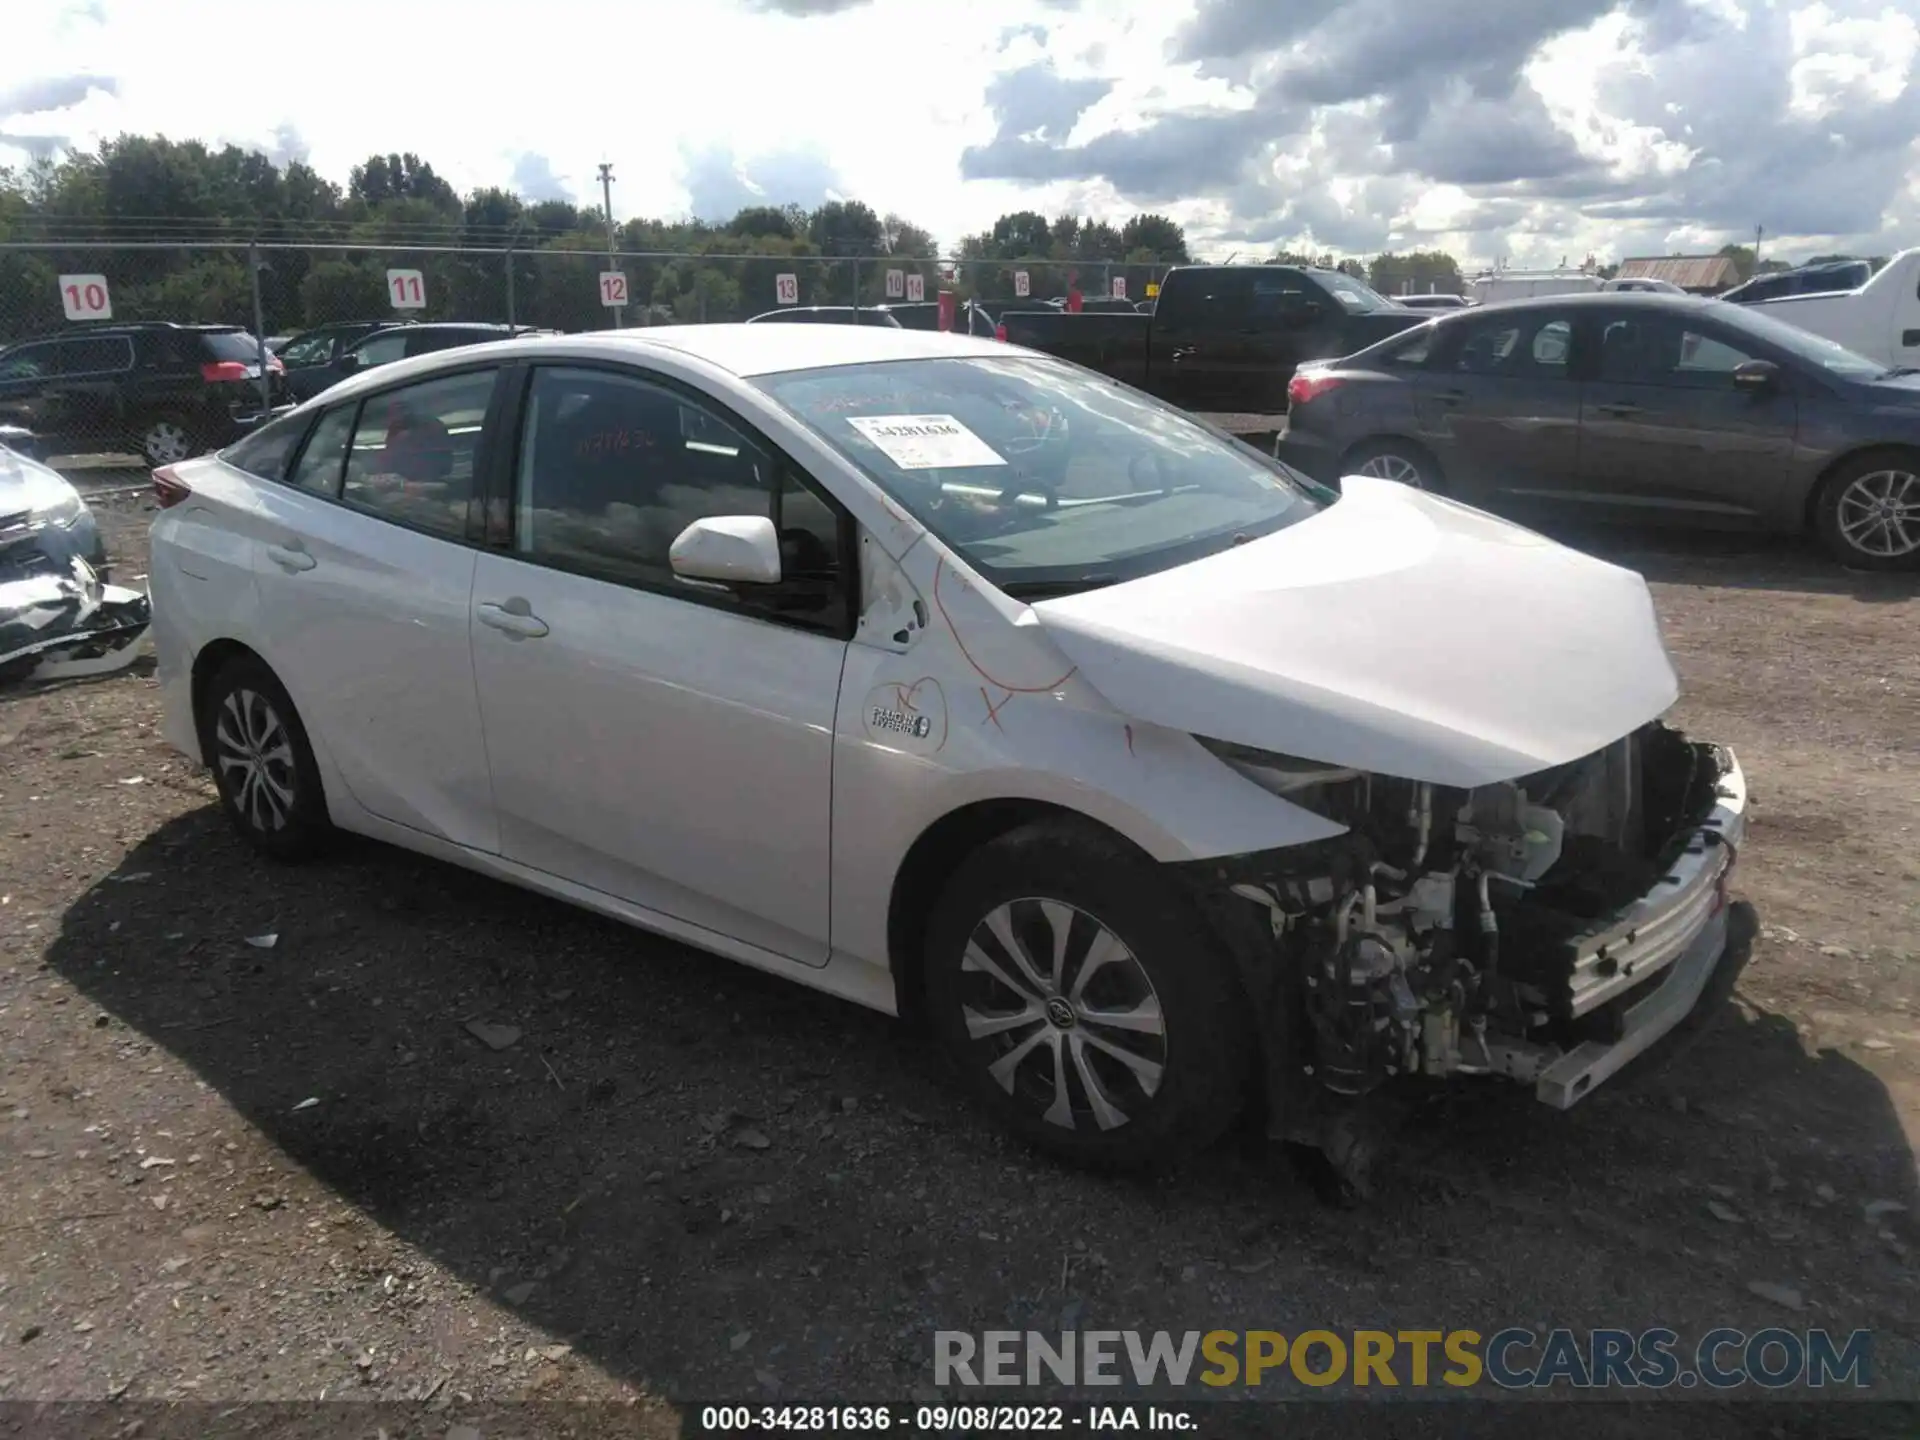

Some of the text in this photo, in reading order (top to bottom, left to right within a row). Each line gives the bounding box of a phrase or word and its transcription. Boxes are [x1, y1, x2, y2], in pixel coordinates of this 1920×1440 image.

[65, 284, 105, 311] 10
[393, 276, 420, 301] 11
[603, 278, 625, 300] 12
[779, 279, 795, 298] 13
[871, 424, 960, 438] 34281636
